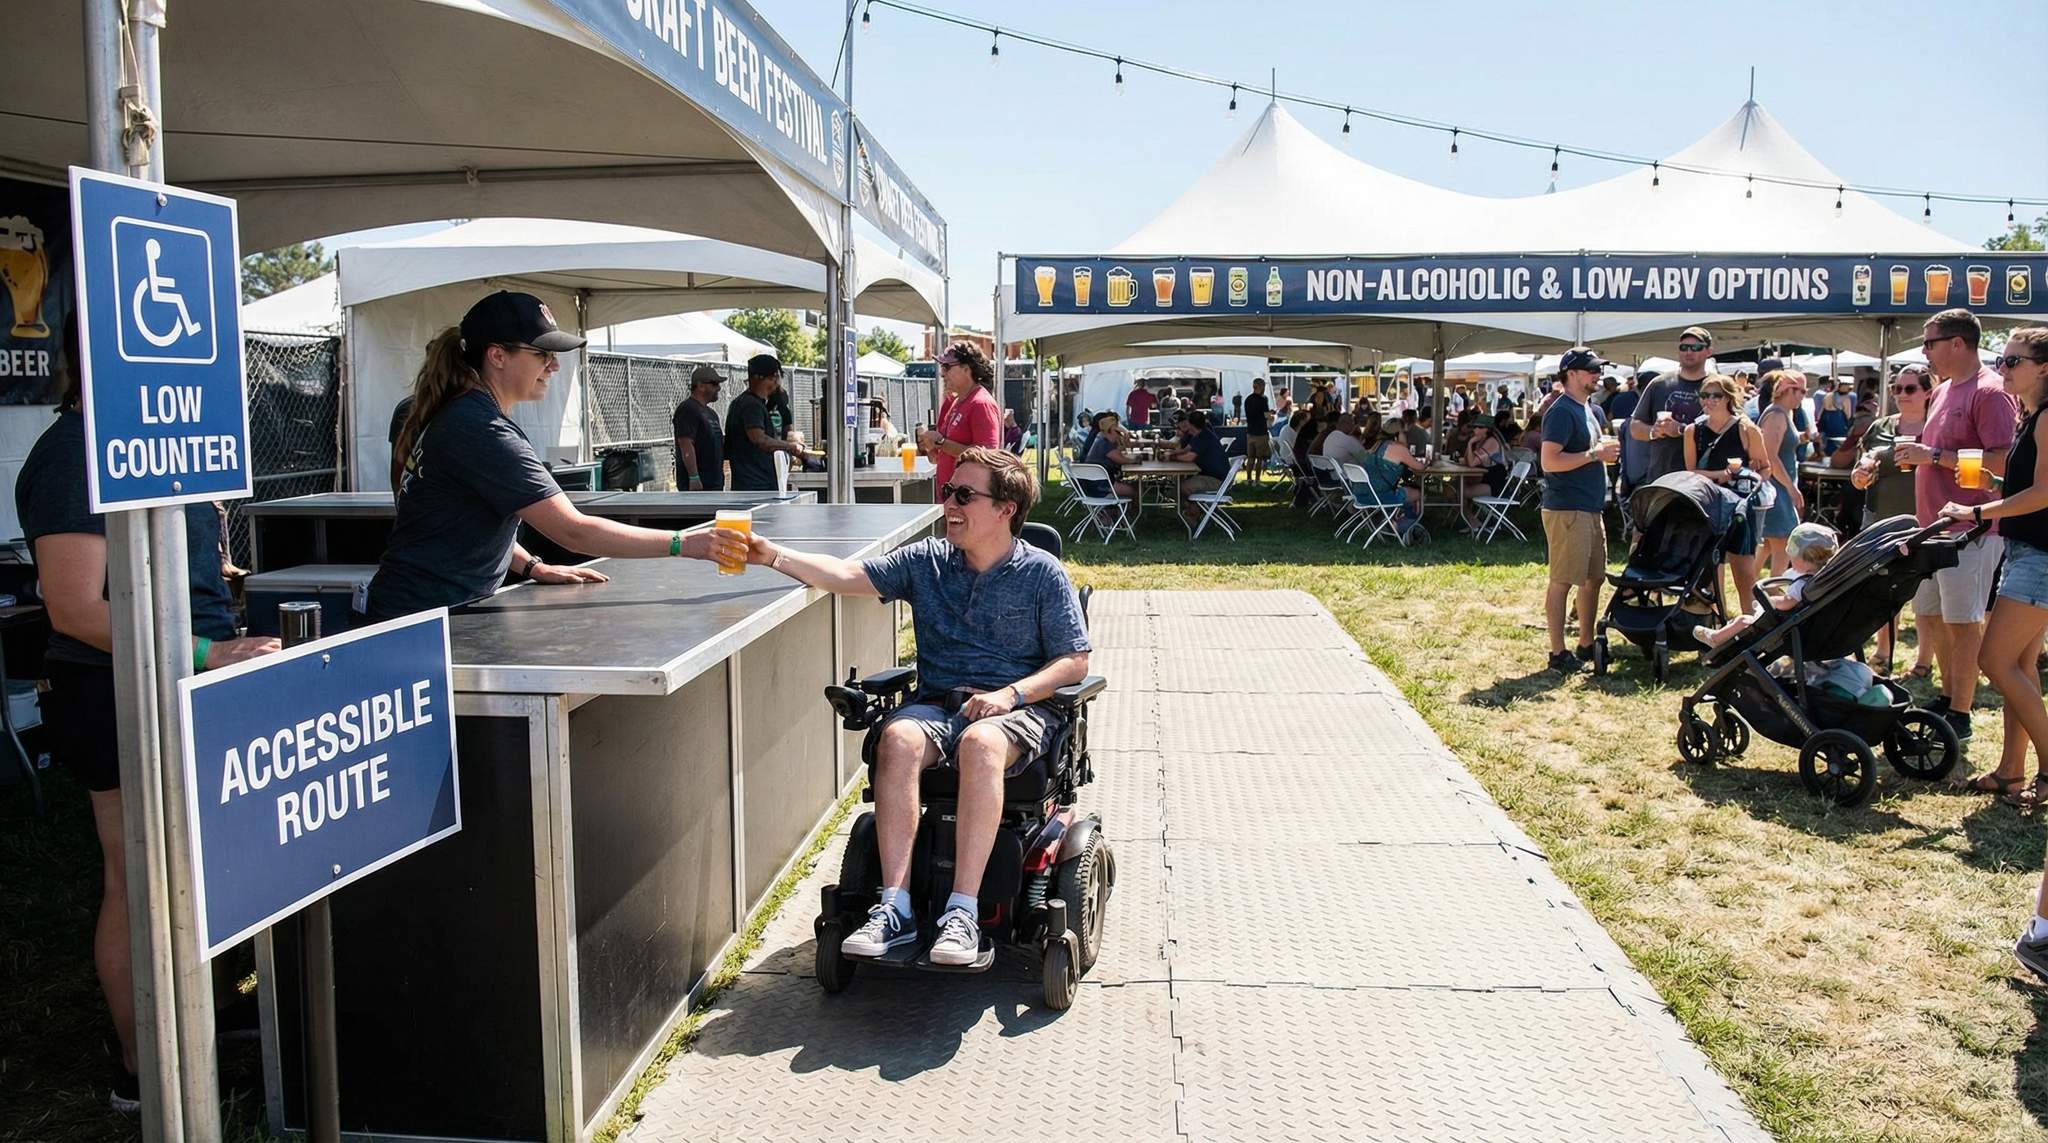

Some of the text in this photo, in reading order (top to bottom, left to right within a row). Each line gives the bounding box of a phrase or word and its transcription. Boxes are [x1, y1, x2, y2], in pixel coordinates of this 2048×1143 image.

[626, 0, 828, 166] AFT BEER FESTIVAL
[1307, 267, 1829, 301] NON-ALCOHOLIC & LOW-ABV OPTIONS
[0, 350, 50, 376] BEER
[140, 385, 202, 424] LOW
[106, 435, 239, 480] COUNTER
[220, 679, 433, 805] ACCESSIBLE
[277, 753, 391, 846] ROUTE
